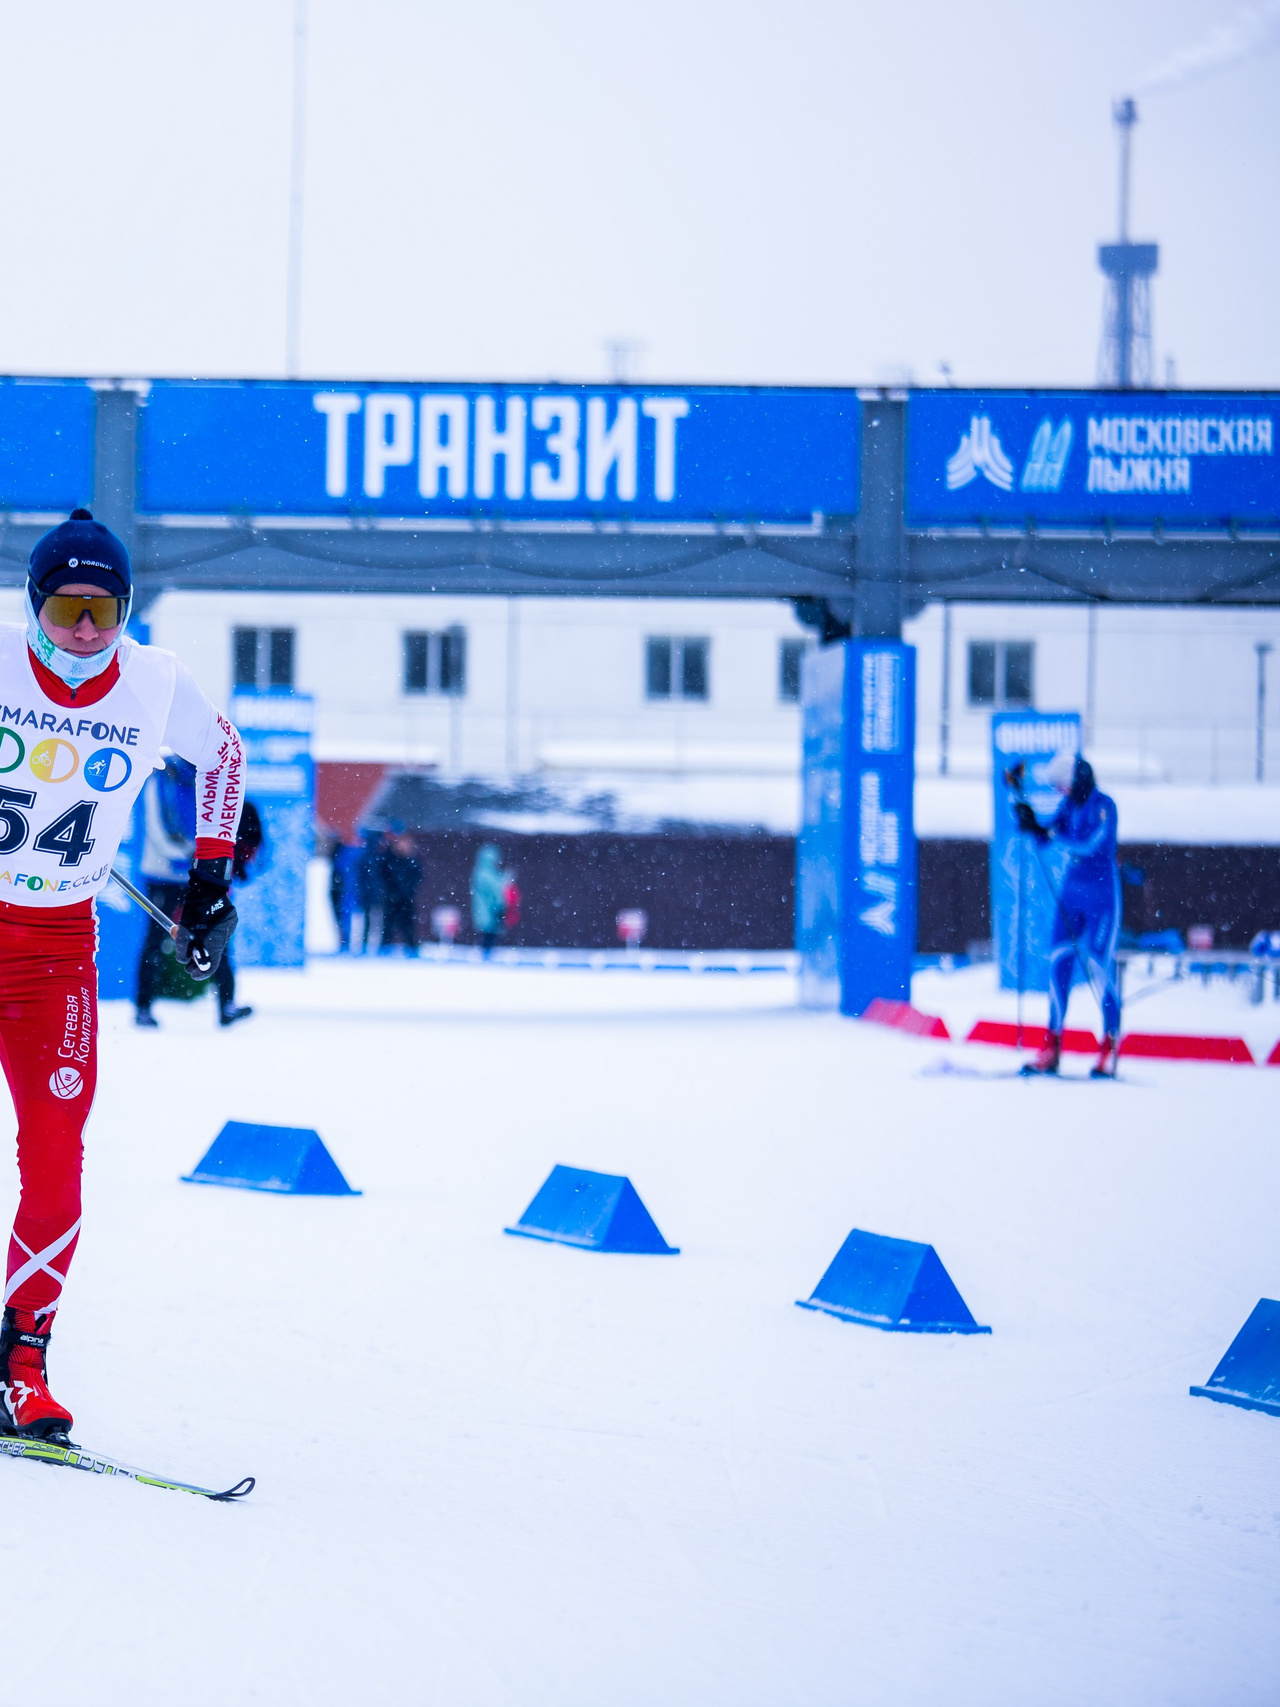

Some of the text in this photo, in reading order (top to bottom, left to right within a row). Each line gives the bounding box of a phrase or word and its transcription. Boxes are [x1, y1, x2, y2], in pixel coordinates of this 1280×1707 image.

[313, 393, 690, 501] ТРАНЗИТ
[1086, 415, 1272, 454] МОСКОВСКАЯ
[1086, 456, 1190, 491] ЛЫЖНЯ
[80, 559, 113, 571] NORDWAY
[57, 994, 79, 1058] Сетевая
[73, 986, 92, 1064] Компания
[19, 1334, 45, 1345] alpina
